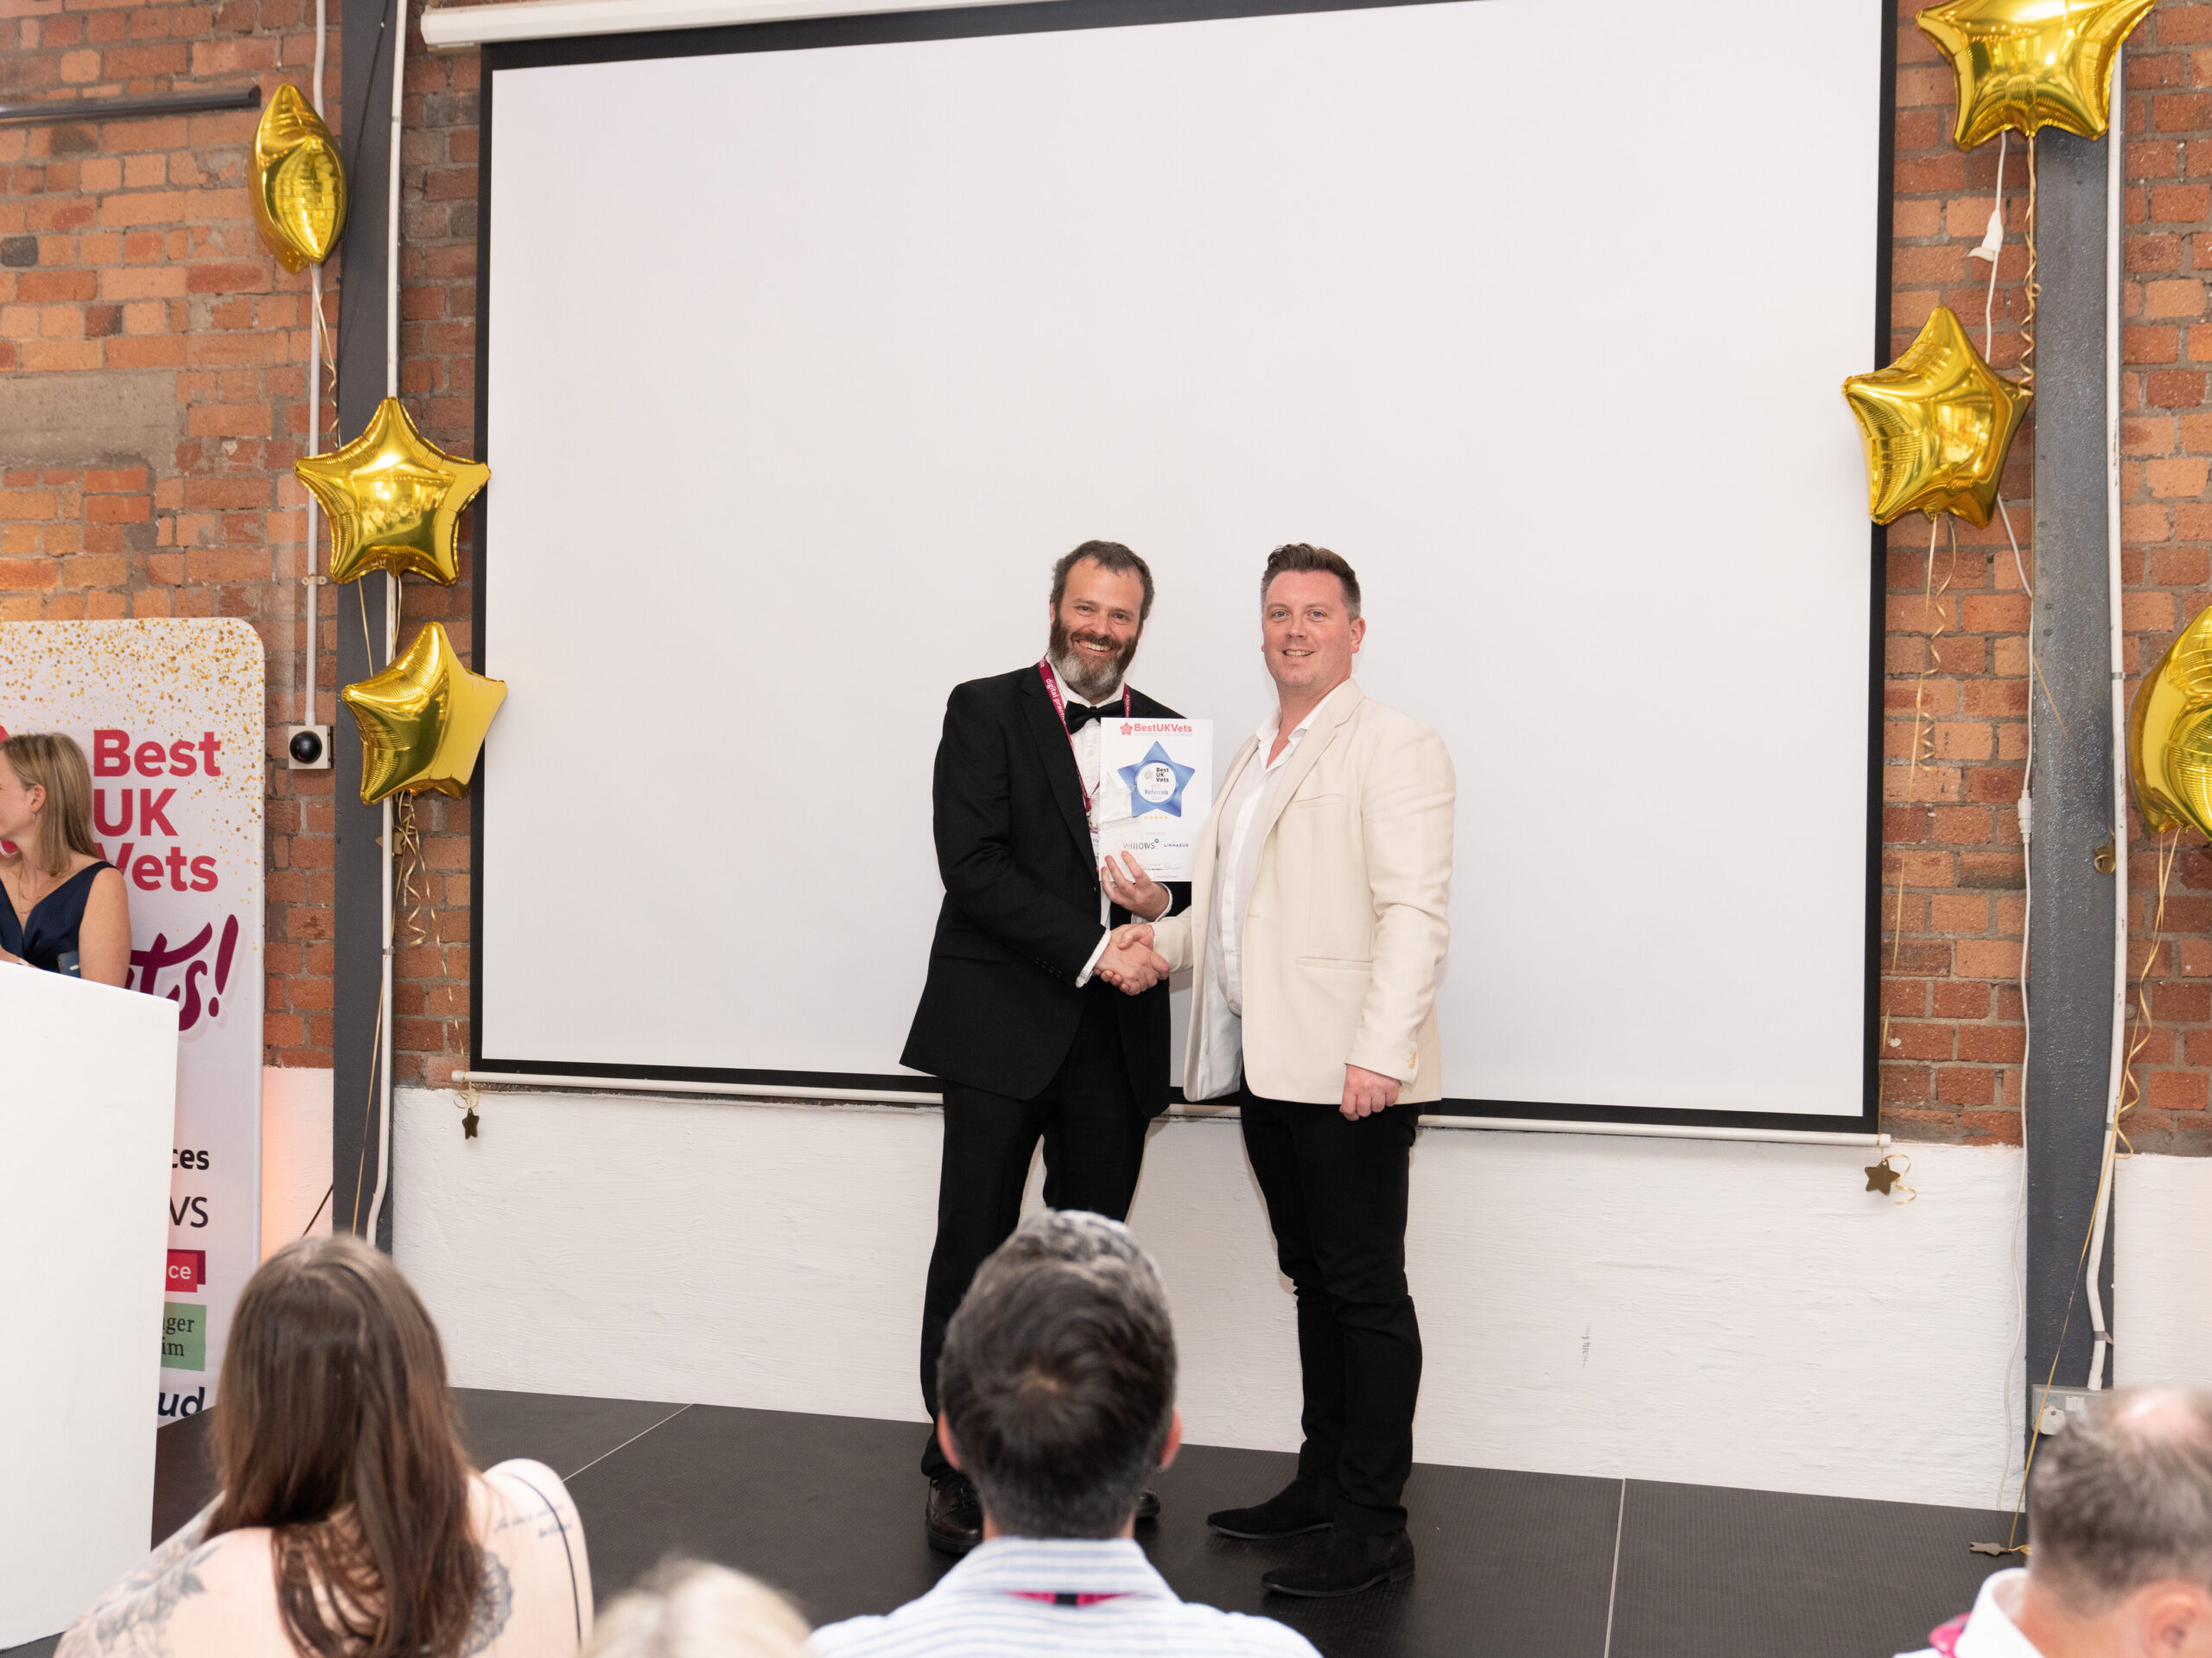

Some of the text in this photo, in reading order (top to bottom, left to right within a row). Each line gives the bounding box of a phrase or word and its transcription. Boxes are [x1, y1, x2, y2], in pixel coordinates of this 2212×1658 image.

[1046, 678, 1059, 698] digital
[1134, 723, 1192, 733] BestUKVets
[93, 730, 221, 778] Best
[93, 789, 179, 836] UK
[95, 843, 219, 893] Vets
[168, 1265, 192, 1280] ce
